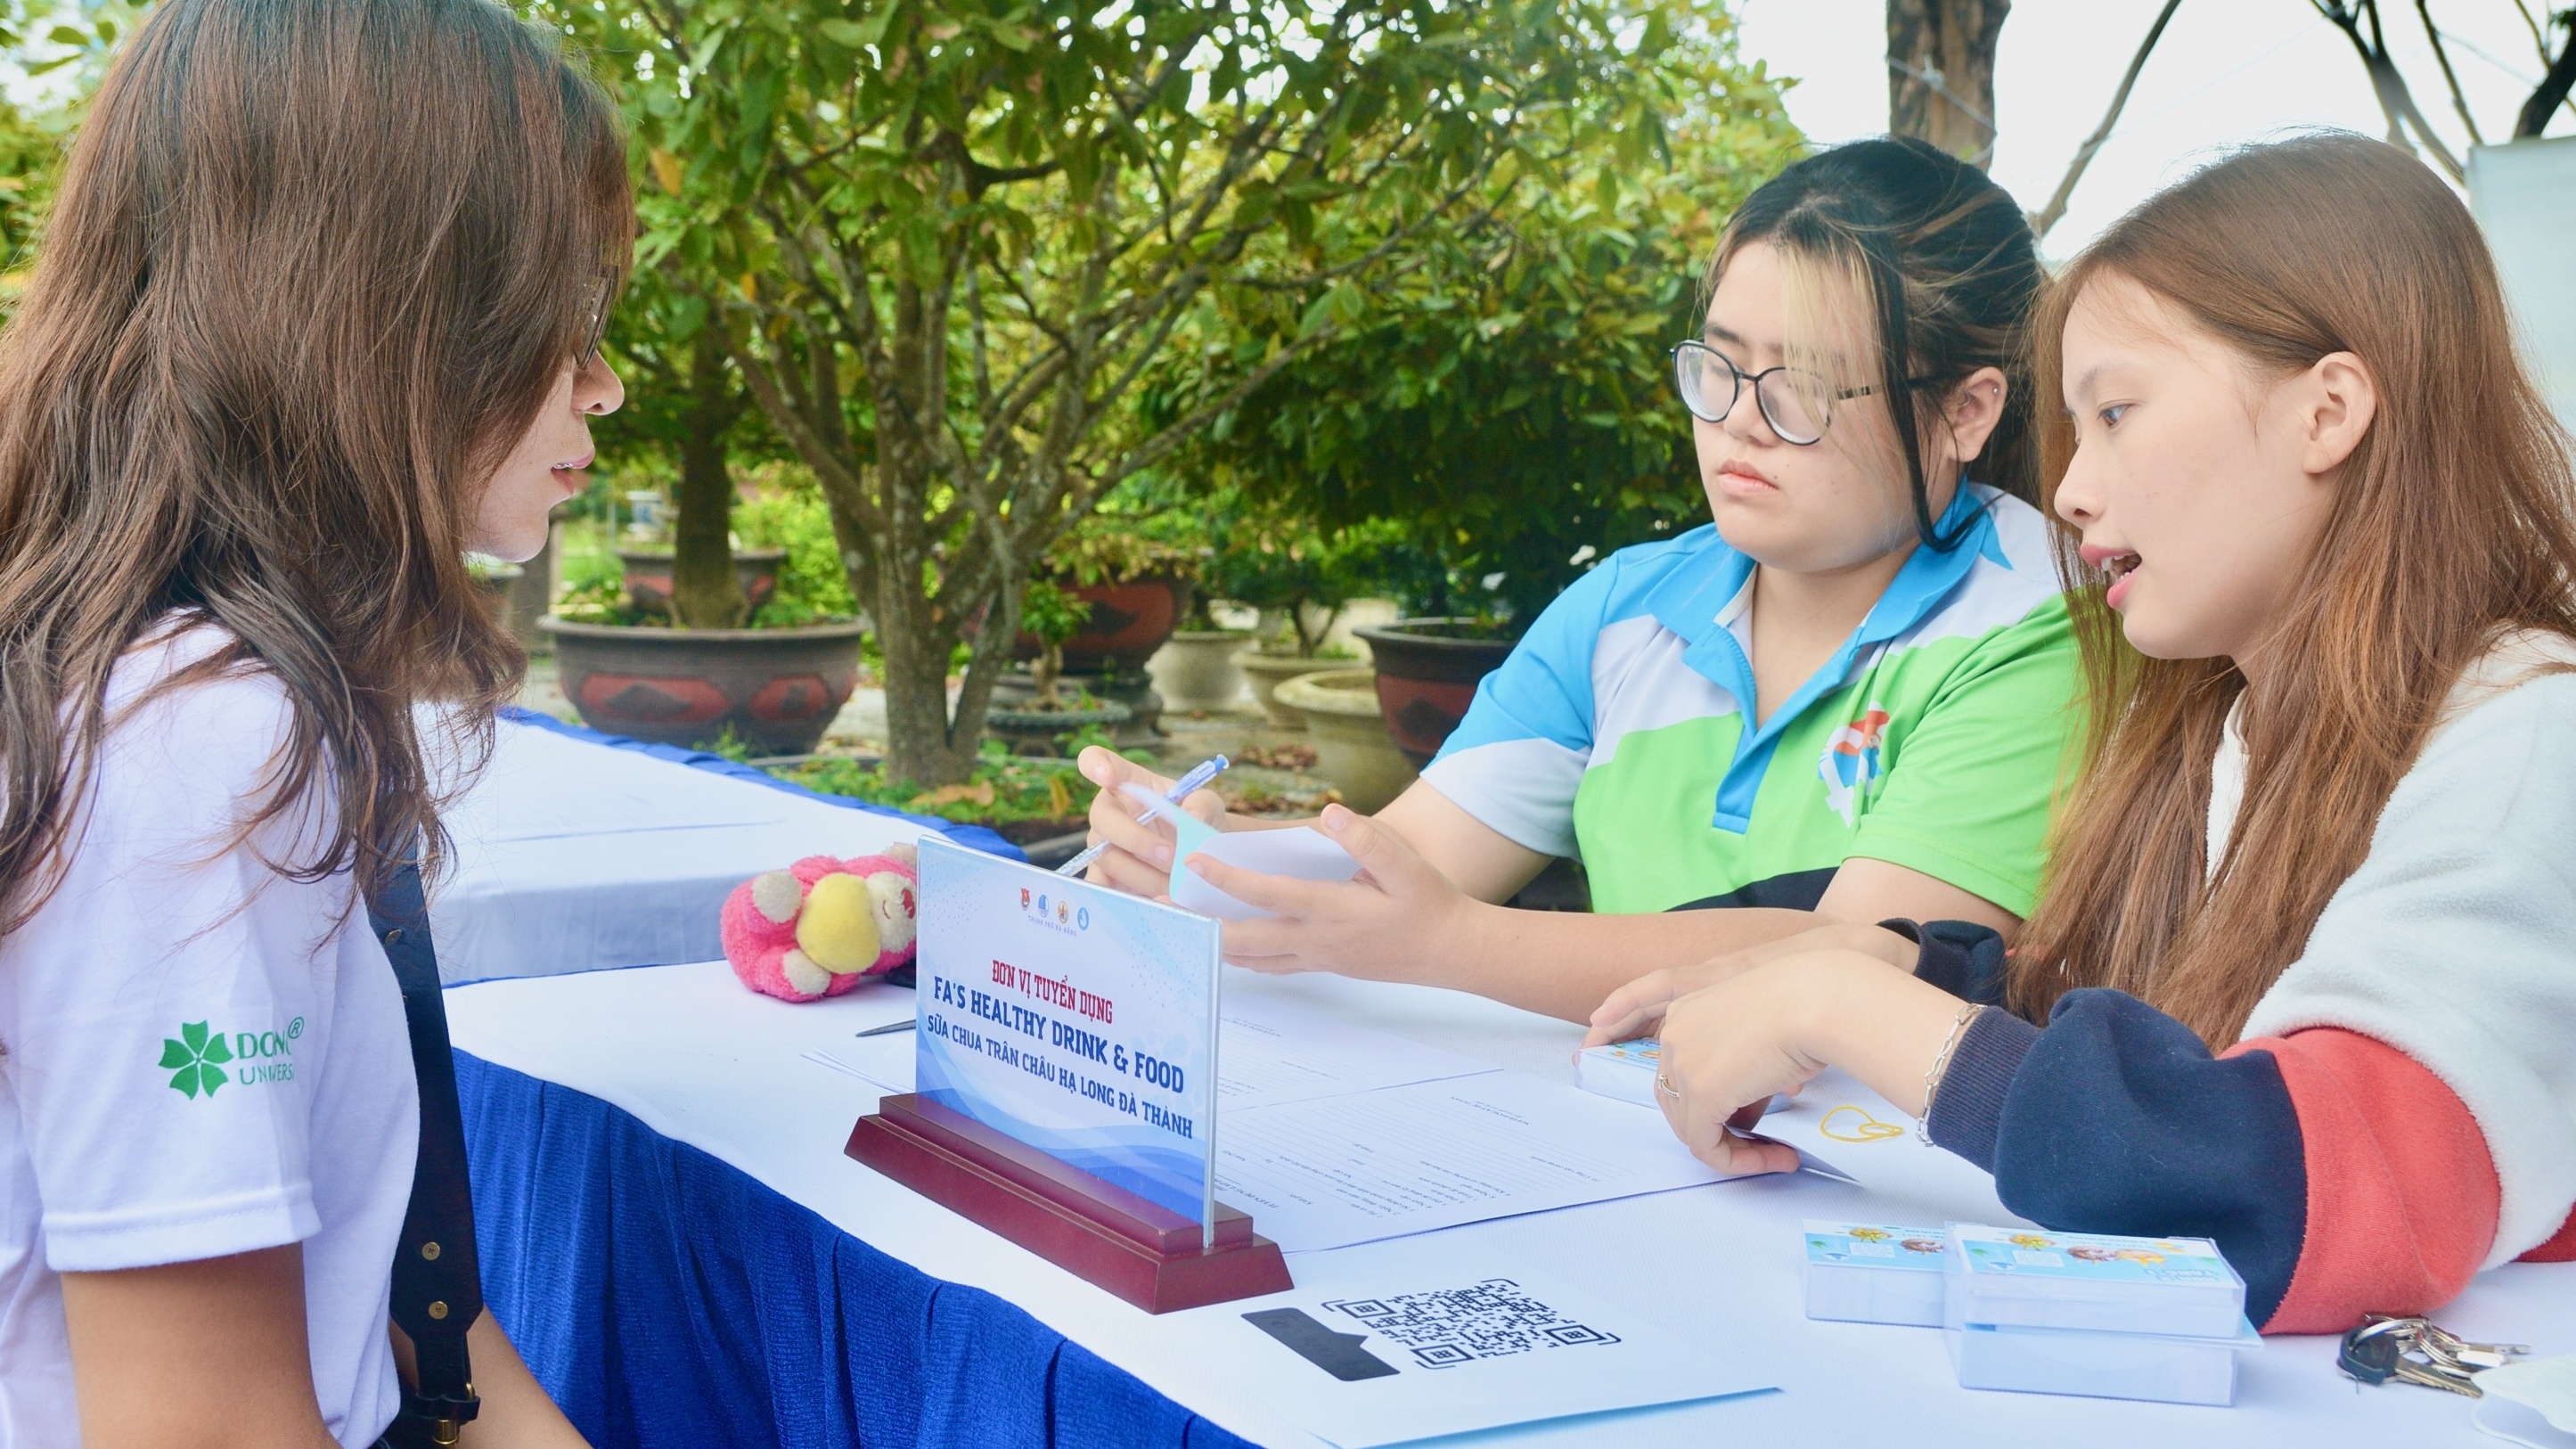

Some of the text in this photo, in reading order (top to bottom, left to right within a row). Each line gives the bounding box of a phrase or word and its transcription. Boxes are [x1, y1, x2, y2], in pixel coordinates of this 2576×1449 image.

[934, 976, 966, 1009] FA'S
[970, 989, 1046, 1040] HEALTHY
[1051, 1019, 1108, 1065] DRINK
[1113, 1044, 1129, 1075] &
[1134, 1052, 1184, 1093] FOOD
[992, 960, 1113, 1025] ĐƠN VỊ TUYỂN DỤNG
[928, 1013, 1192, 1139] SỮA CHUA TRÂN CHÂU HẠ LONG ĐÀ THÀNH
